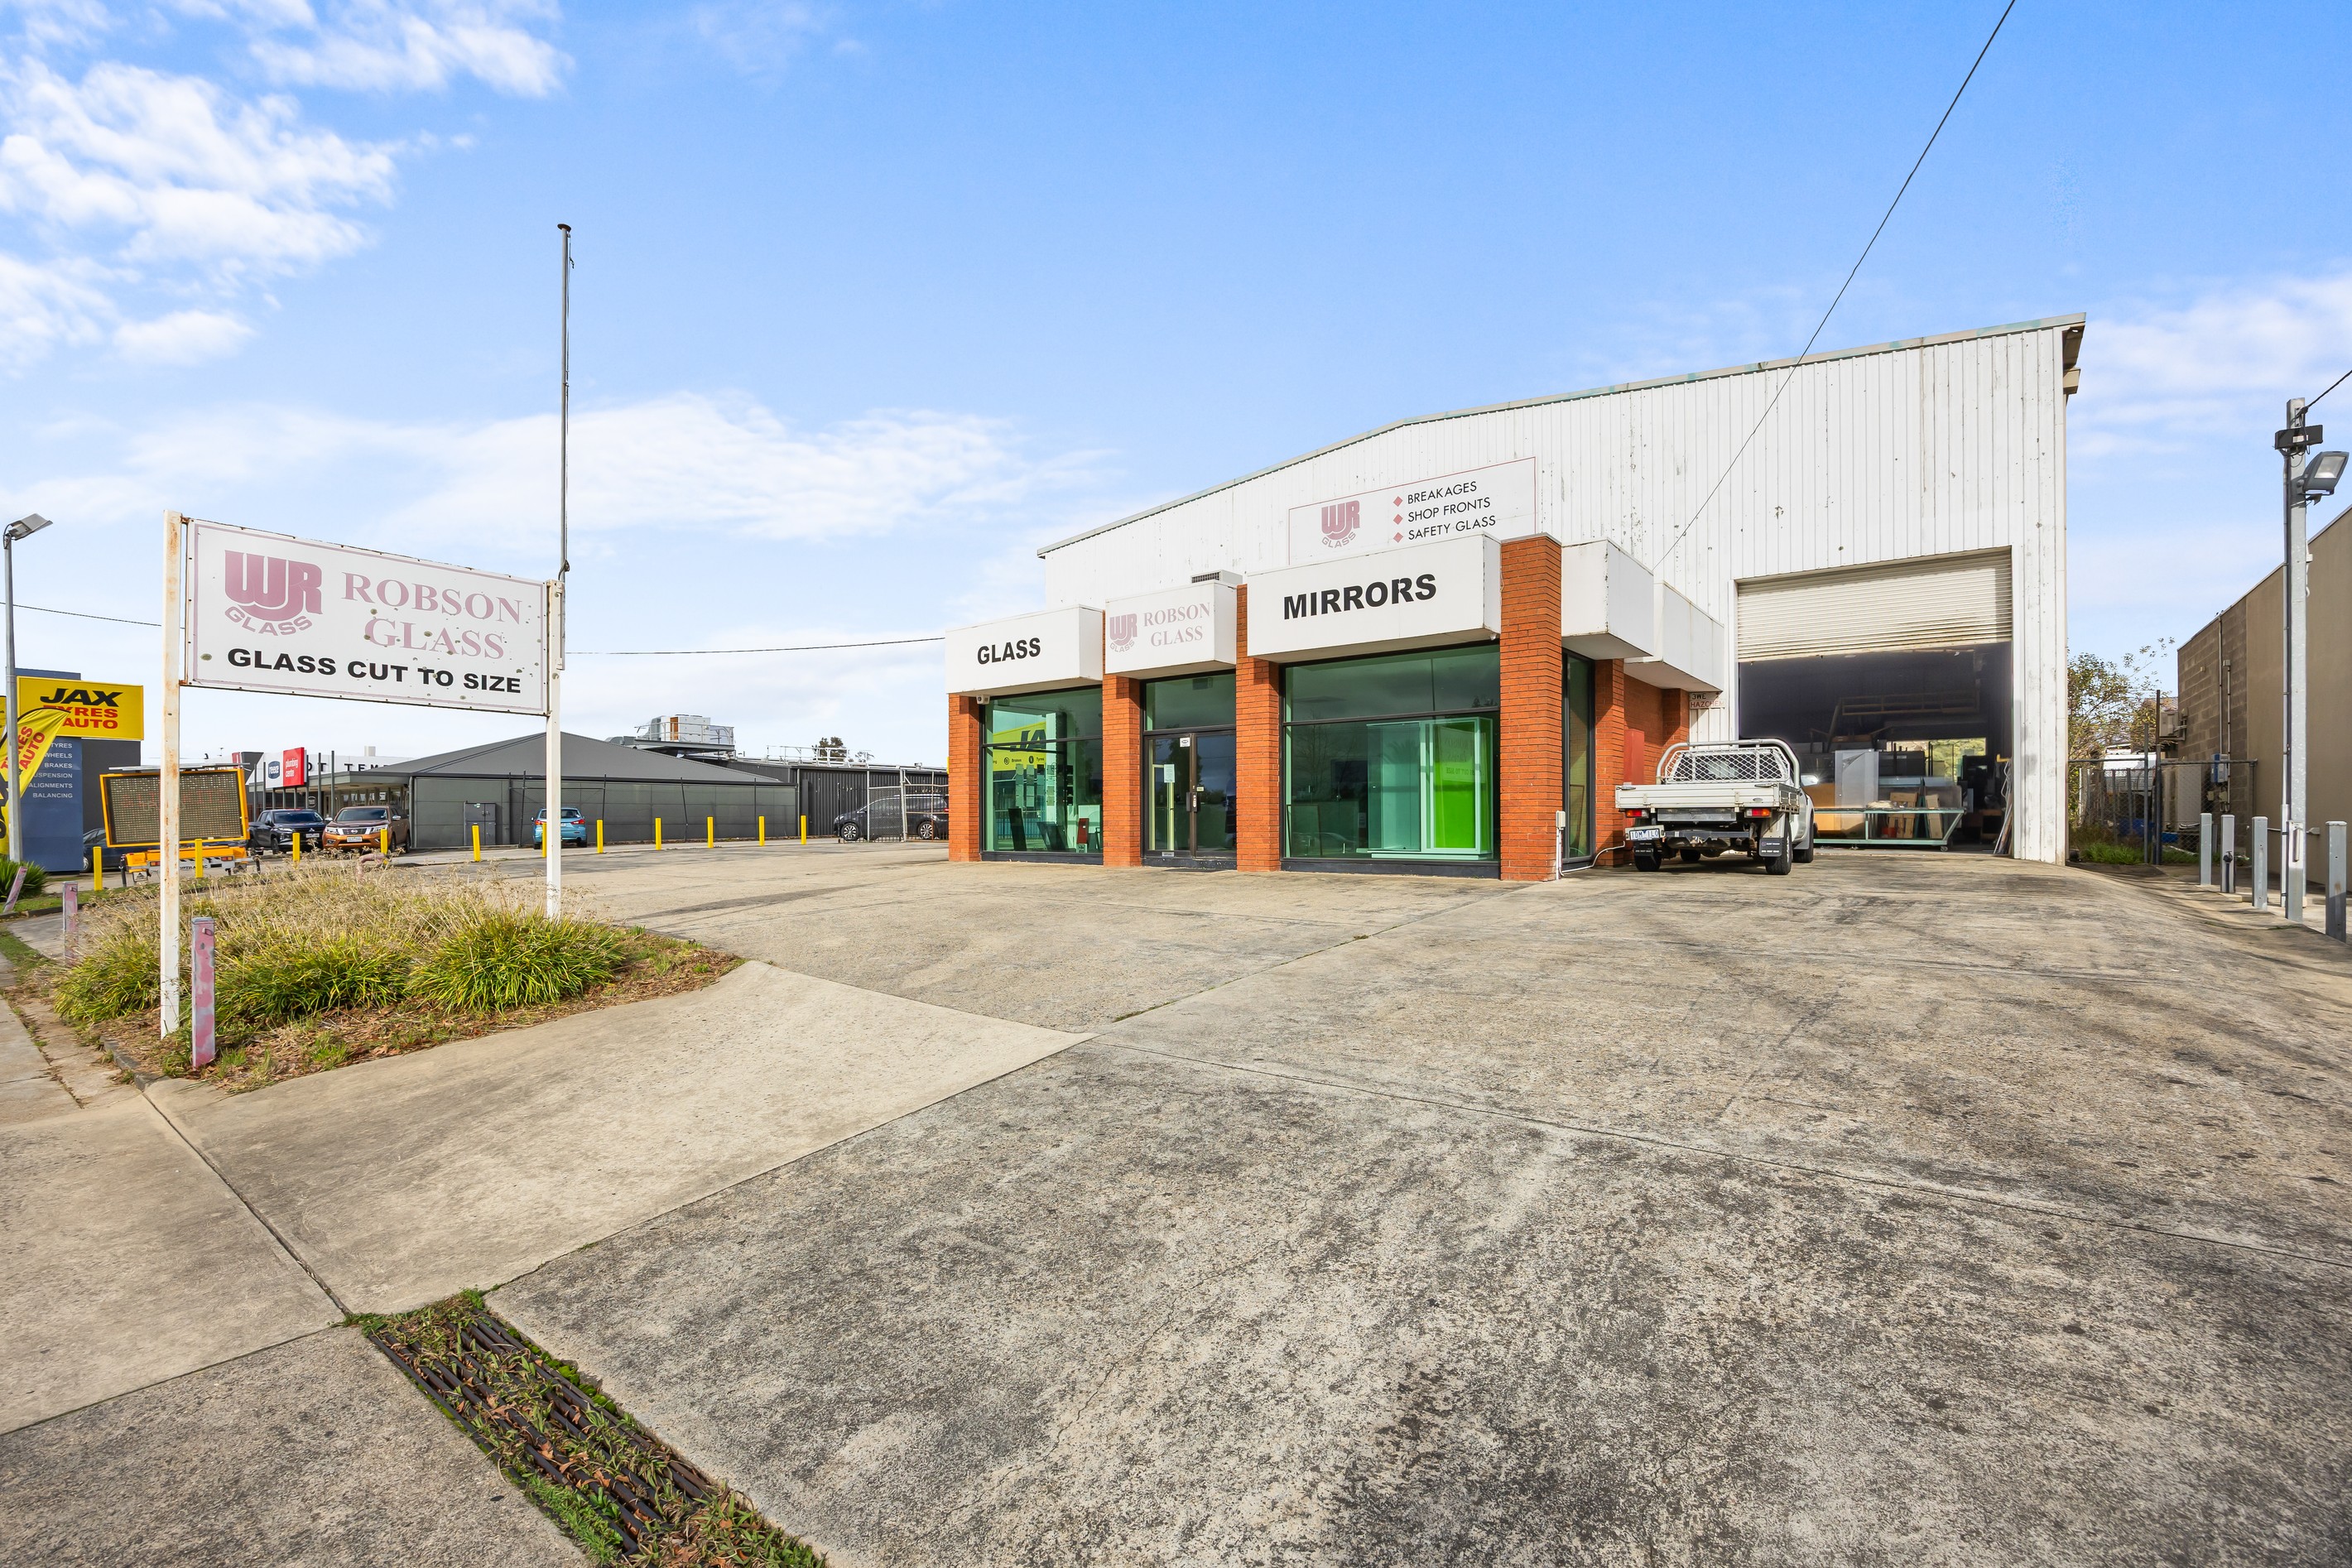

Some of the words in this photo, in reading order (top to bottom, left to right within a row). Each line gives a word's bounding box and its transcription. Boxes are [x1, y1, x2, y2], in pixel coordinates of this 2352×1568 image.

[1407, 481, 1477, 504] BREAKAGES
[1408, 507, 1440, 523] SHOP
[1443, 497, 1491, 516] FRONTS
[1322, 531, 1357, 549] GLASS
[1408, 523, 1450, 541] SAFETY
[1455, 515, 1497, 532] GLASS
[341, 571, 523, 625] ROBSON
[1283, 574, 1437, 620] MIRRORS
[224, 605, 313, 636] GLASS
[1143, 602, 1211, 628] ROBSON
[363, 617, 505, 660] GLASS
[1109, 639, 1135, 652] GLASS
[1150, 625, 1203, 647] GLASS
[977, 637, 1041, 665] GLASS
[227, 647, 337, 676] GLASS
[347, 660, 409, 683] CUT
[417, 667, 455, 688] TO
[463, 672, 522, 694] SIZE
[40, 688, 123, 707] JAX
[62, 717, 118, 729] AUTO
[19, 732, 46, 770] AUTO
